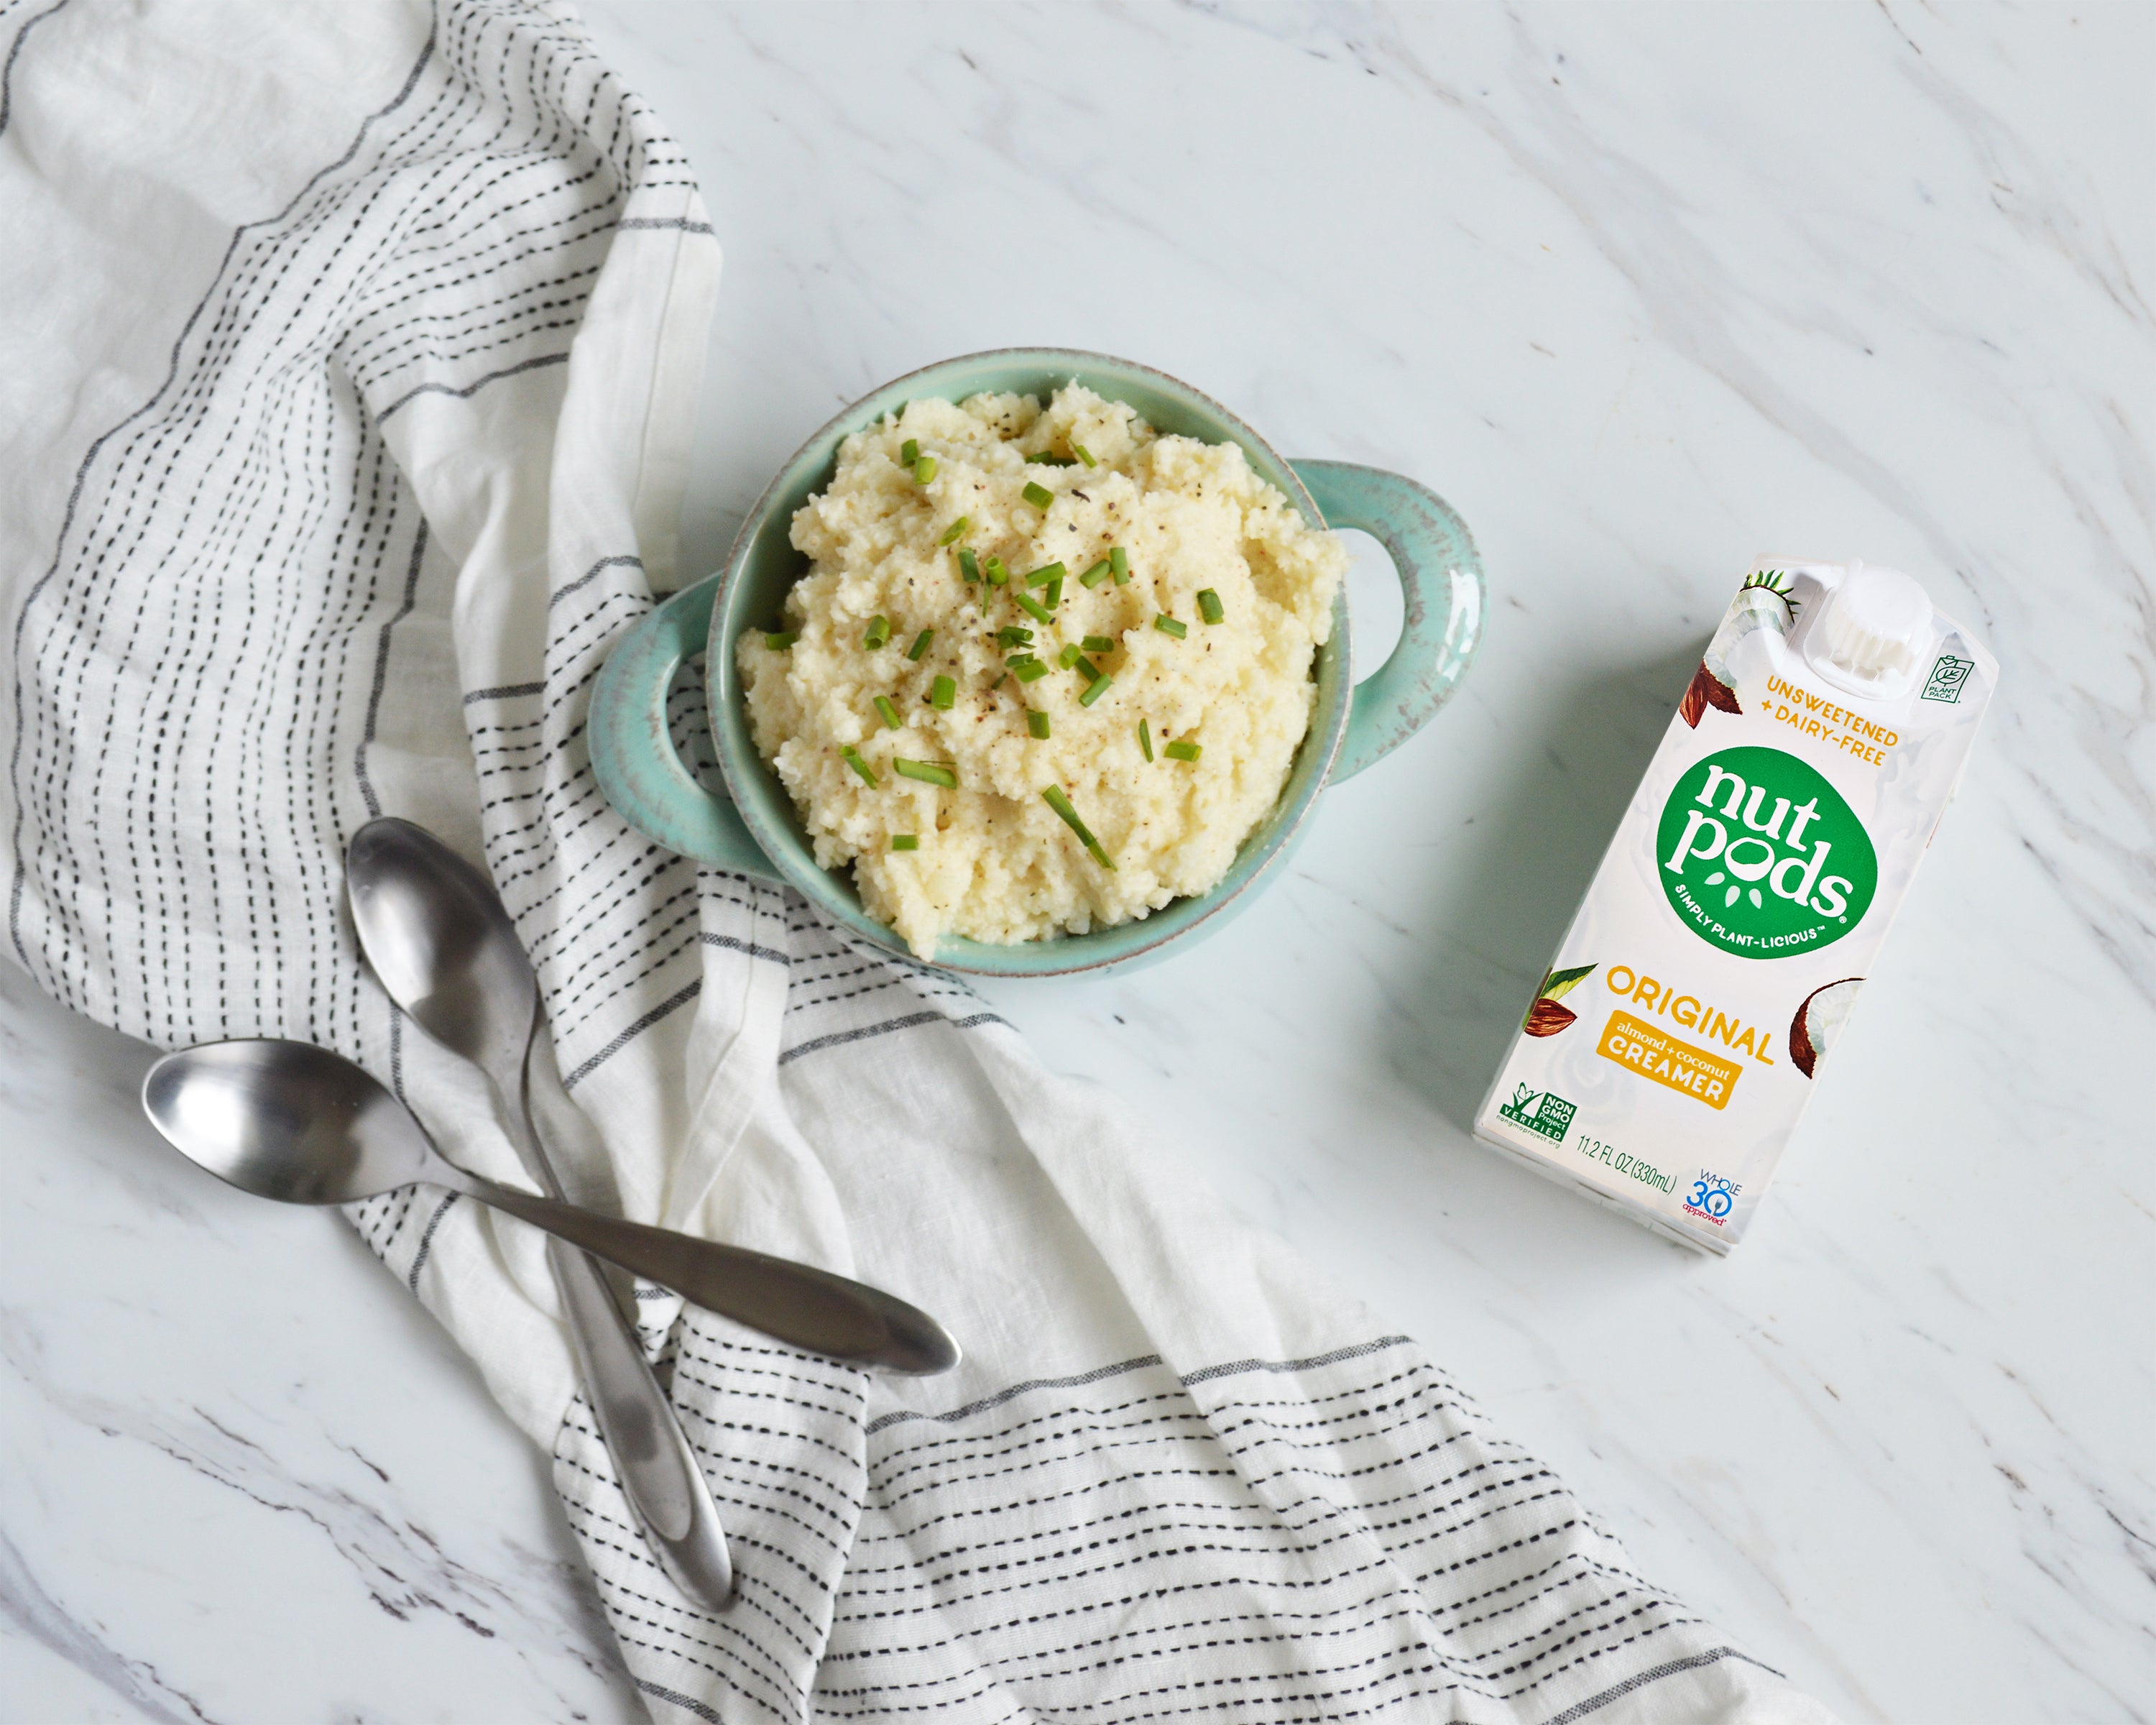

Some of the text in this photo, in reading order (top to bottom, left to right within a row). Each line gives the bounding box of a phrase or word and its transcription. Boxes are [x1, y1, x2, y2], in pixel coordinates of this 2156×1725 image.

[1928, 686, 1957, 694] PLANT
[1928, 691, 1951, 699] PACK
[1767, 675, 1899, 747] UNSWEETENED
[1774, 706, 1886, 766] DAIRY-FREE
[1695, 765, 1821, 852] nut
[1675, 884, 1713, 926] SIMPLY
[1606, 965, 1774, 1065] ORIGINAL
[1608, 1035, 1724, 1101] CREAMER
[1616, 1021, 1666, 1051] almond
[1676, 1048, 1731, 1080] coconut
[1504, 1107, 1562, 1139] VERIFIED
[1539, 1113, 1567, 1131] Project
[1542, 1105, 1570, 1123] GMO
[1546, 1096, 1574, 1114] NON
[1496, 1115, 1561, 1149] nongmoproject.org
[1577, 1135, 1677, 1195] 11.2 FL OZ (330mL)
[1700, 1169, 1743, 1196] WHOLE
[1686, 1181, 1733, 1217] 30
